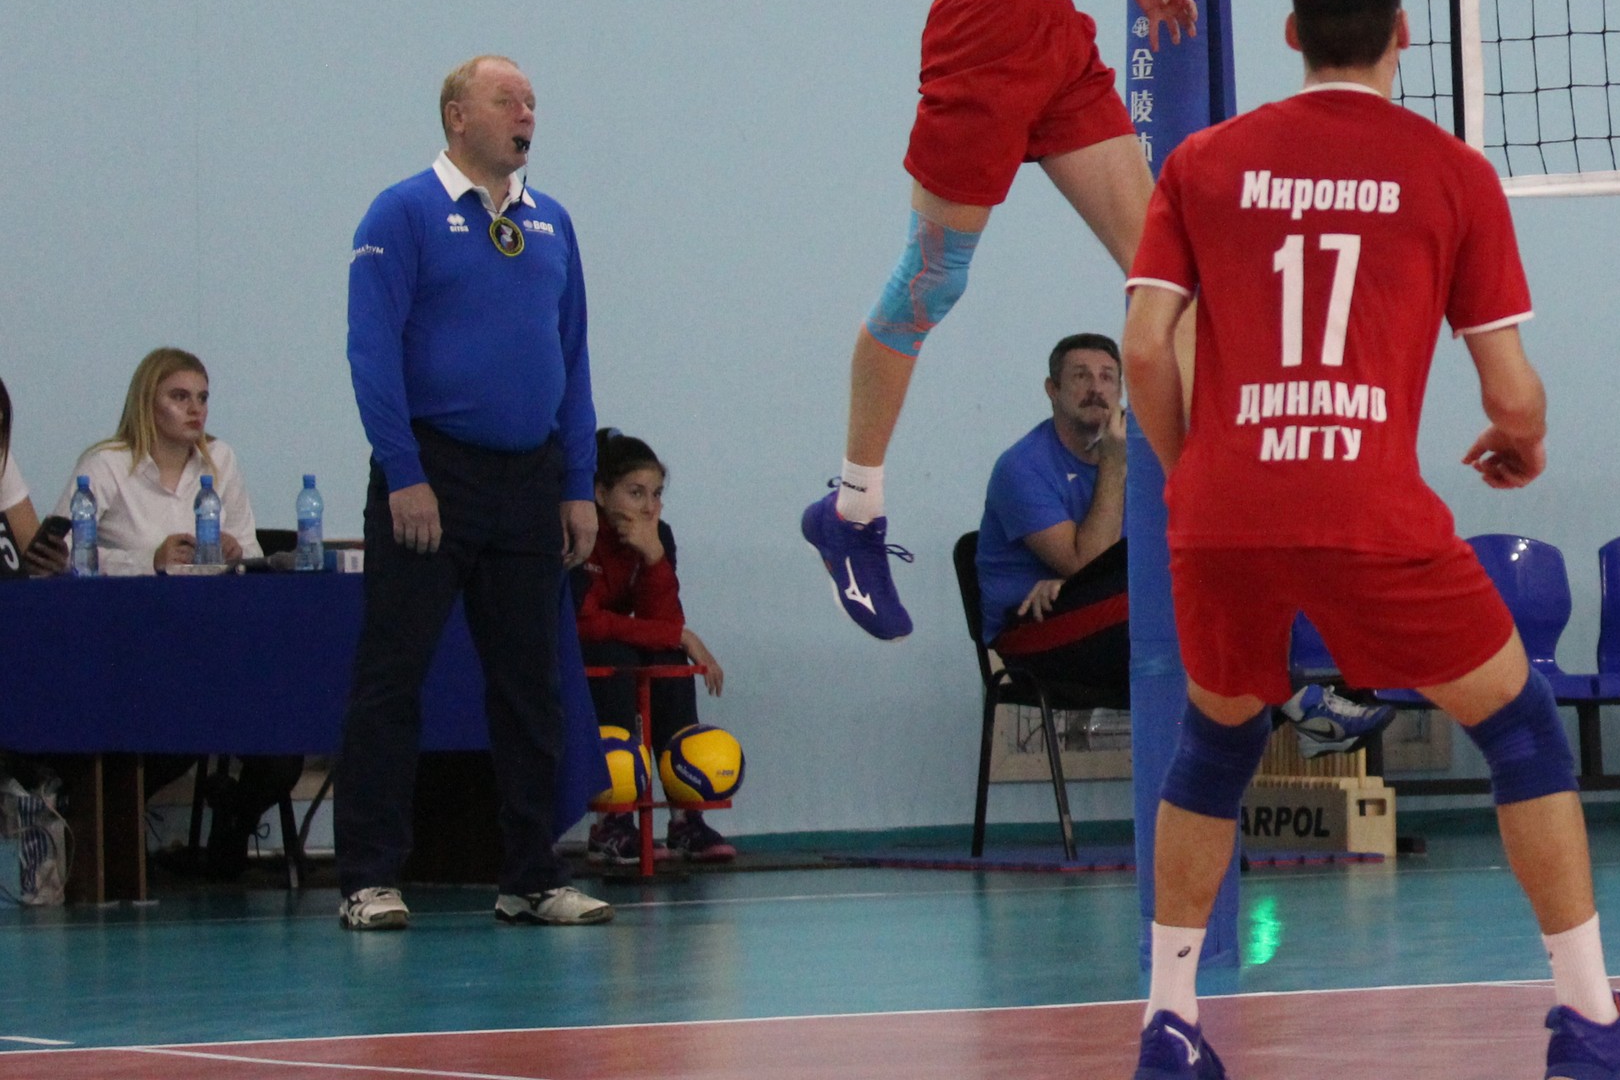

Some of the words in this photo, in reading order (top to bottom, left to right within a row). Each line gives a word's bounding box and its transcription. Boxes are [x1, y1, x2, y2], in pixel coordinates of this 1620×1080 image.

[1240, 170, 1401, 220] Миронов
[1273, 233, 1361, 367] 17
[1236, 380, 1387, 426] ДИНАМО
[1260, 425, 1362, 462] МГТУ
